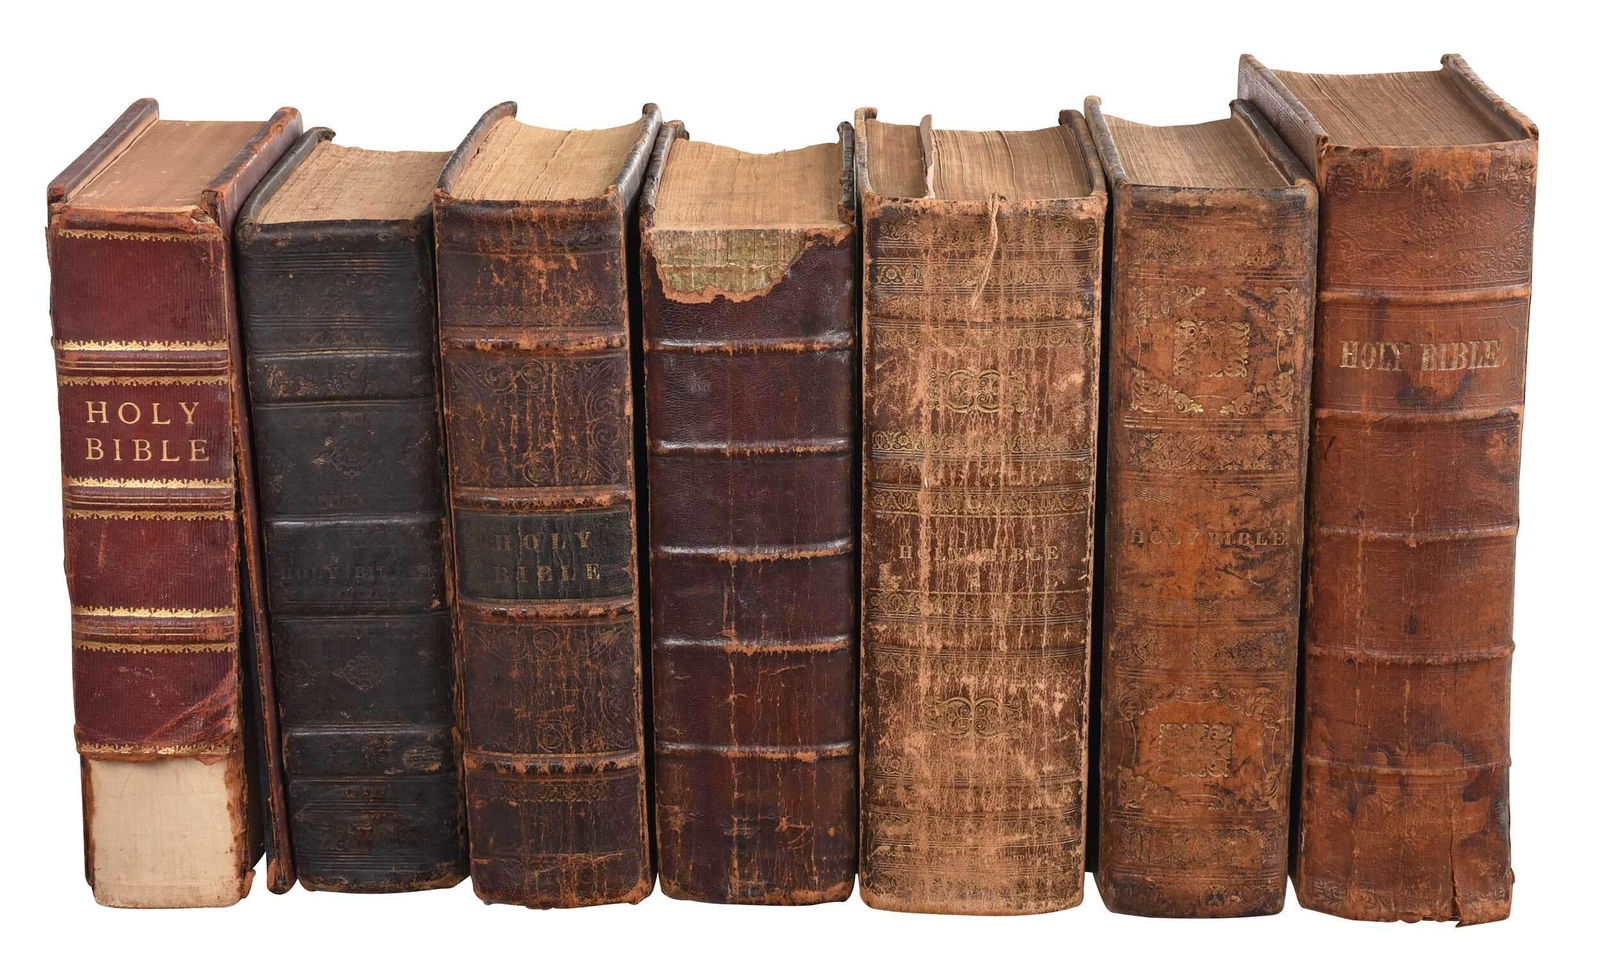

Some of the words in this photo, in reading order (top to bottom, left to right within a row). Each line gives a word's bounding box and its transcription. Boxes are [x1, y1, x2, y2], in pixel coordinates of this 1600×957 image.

[1340, 340, 1413, 371] HOLY
[1420, 338, 1501, 371] BIBLE
[85, 400, 200, 425] HOLY
[85, 437, 210, 462] BIBLE
[494, 531, 592, 551] HOLY
[1130, 529, 1200, 546] HOLY
[1208, 530, 1287, 546] BIBLE
[493, 563, 601, 583] BIBLE
